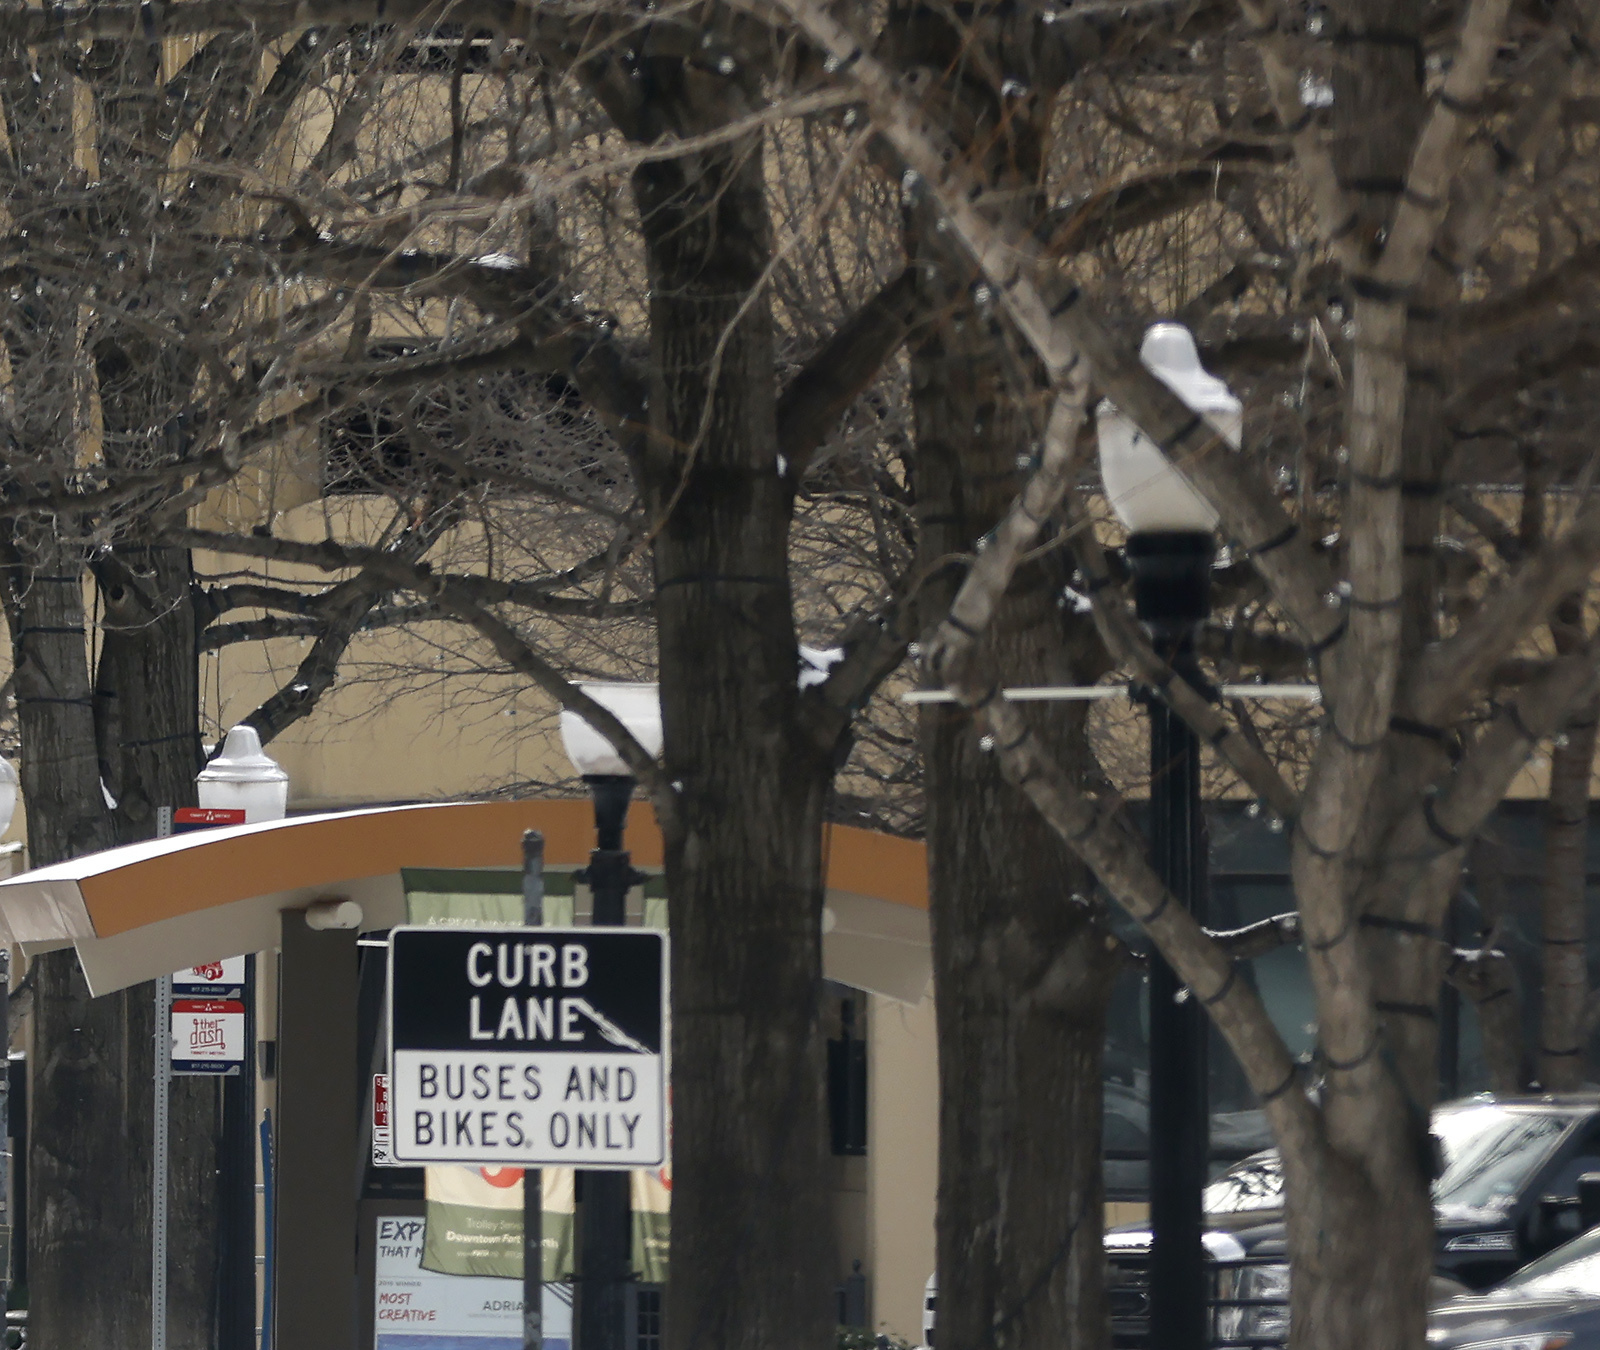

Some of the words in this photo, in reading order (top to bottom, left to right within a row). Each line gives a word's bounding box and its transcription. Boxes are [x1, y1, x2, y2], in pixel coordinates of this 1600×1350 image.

[467, 943, 589, 988] CURB
[201, 1018, 216, 1030] the
[470, 997, 585, 1041] LANE
[190, 1019, 225, 1049] dash
[419, 1064, 542, 1100] BUSES
[565, 1066, 637, 1102] AND
[415, 1111, 525, 1147] BIKES
[550, 1112, 641, 1148] ONLY
[445, 1230, 500, 1244] Downtown
[502, 1233, 521, 1244] Fort
[380, 1246, 411, 1258] THAT
[379, 1293, 412, 1305] MOST
[379, 1309, 436, 1321] CREATIVE
